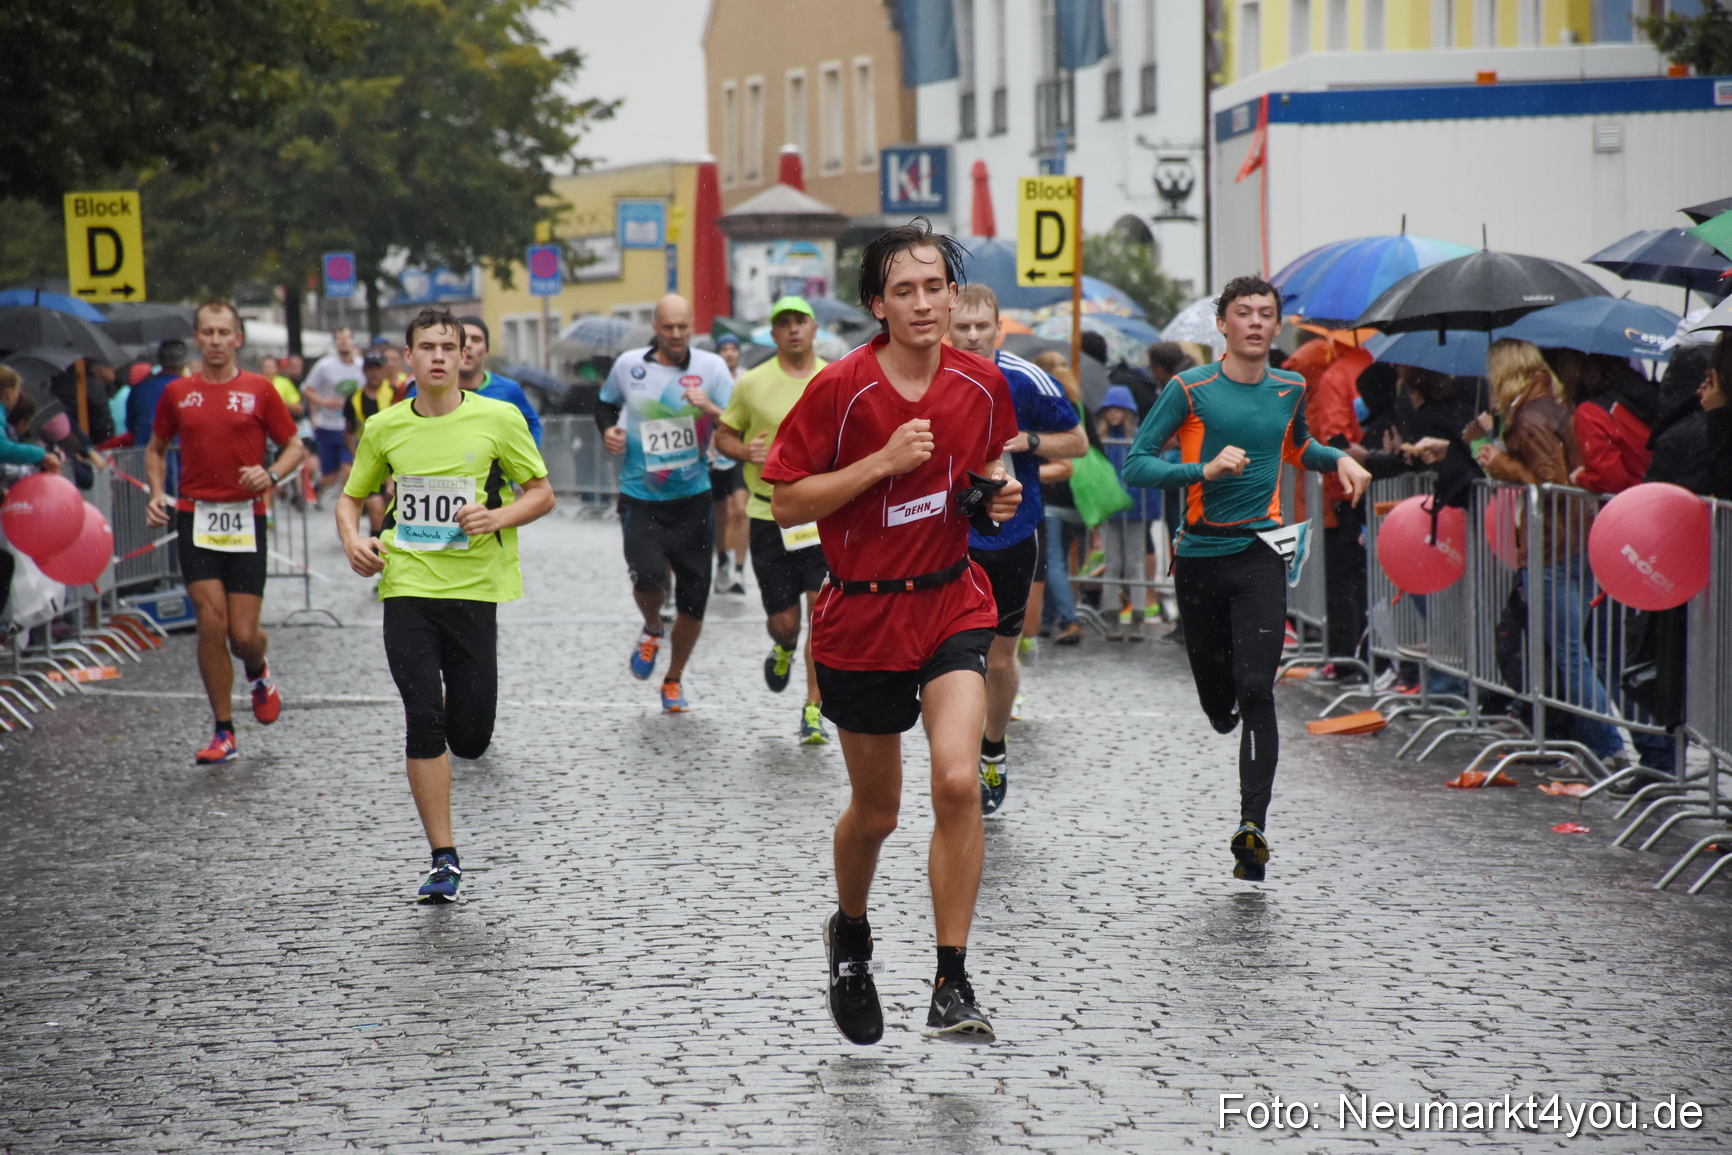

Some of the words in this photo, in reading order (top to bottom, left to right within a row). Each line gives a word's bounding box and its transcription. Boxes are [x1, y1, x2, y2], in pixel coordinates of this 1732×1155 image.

[888, 152, 943, 202] KL
[1025, 181, 1075, 200] Block
[74, 197, 132, 217] Block
[1035, 210, 1065, 260] D
[87, 226, 124, 277] D
[649, 428, 694, 452] 2120
[429, 479, 468, 489] BOCK
[402, 493, 467, 523] 3102
[904, 501, 932, 518] DEHN
[208, 512, 243, 532] 204
